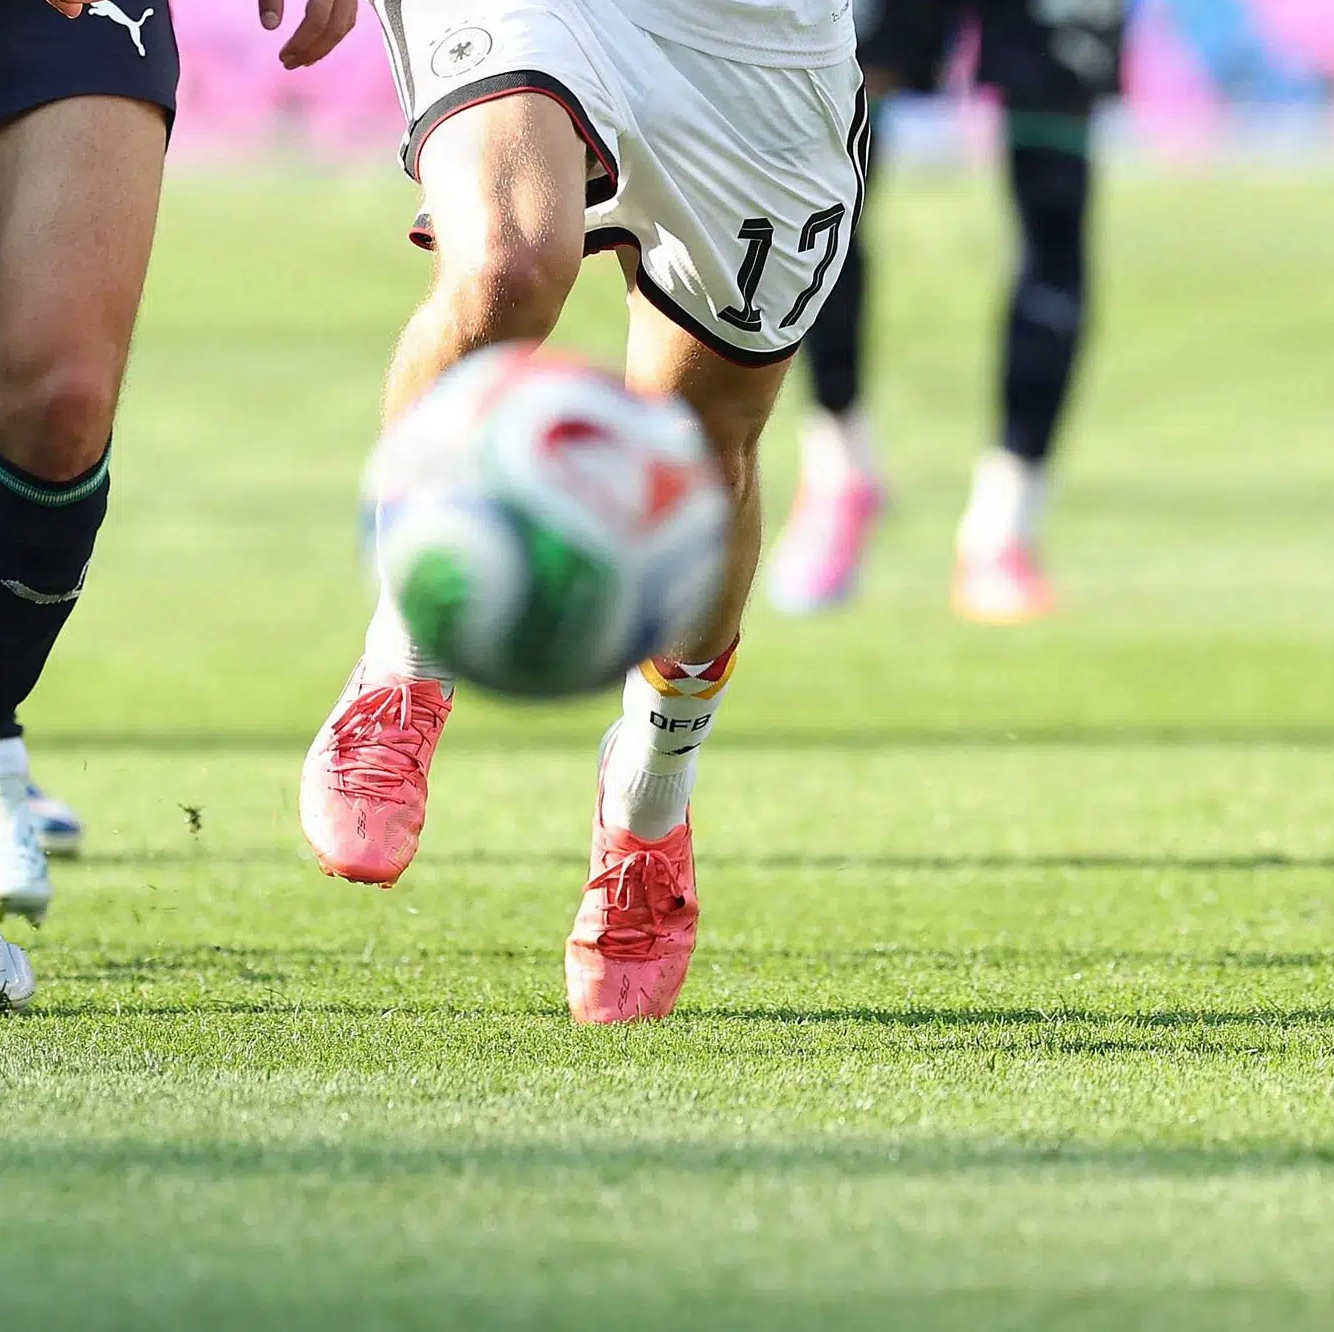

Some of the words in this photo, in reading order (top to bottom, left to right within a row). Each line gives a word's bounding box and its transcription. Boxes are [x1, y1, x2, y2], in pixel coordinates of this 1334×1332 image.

[717, 202, 846, 333] 17
[649, 710, 712, 733] DFB
[357, 808, 367, 840] F50
